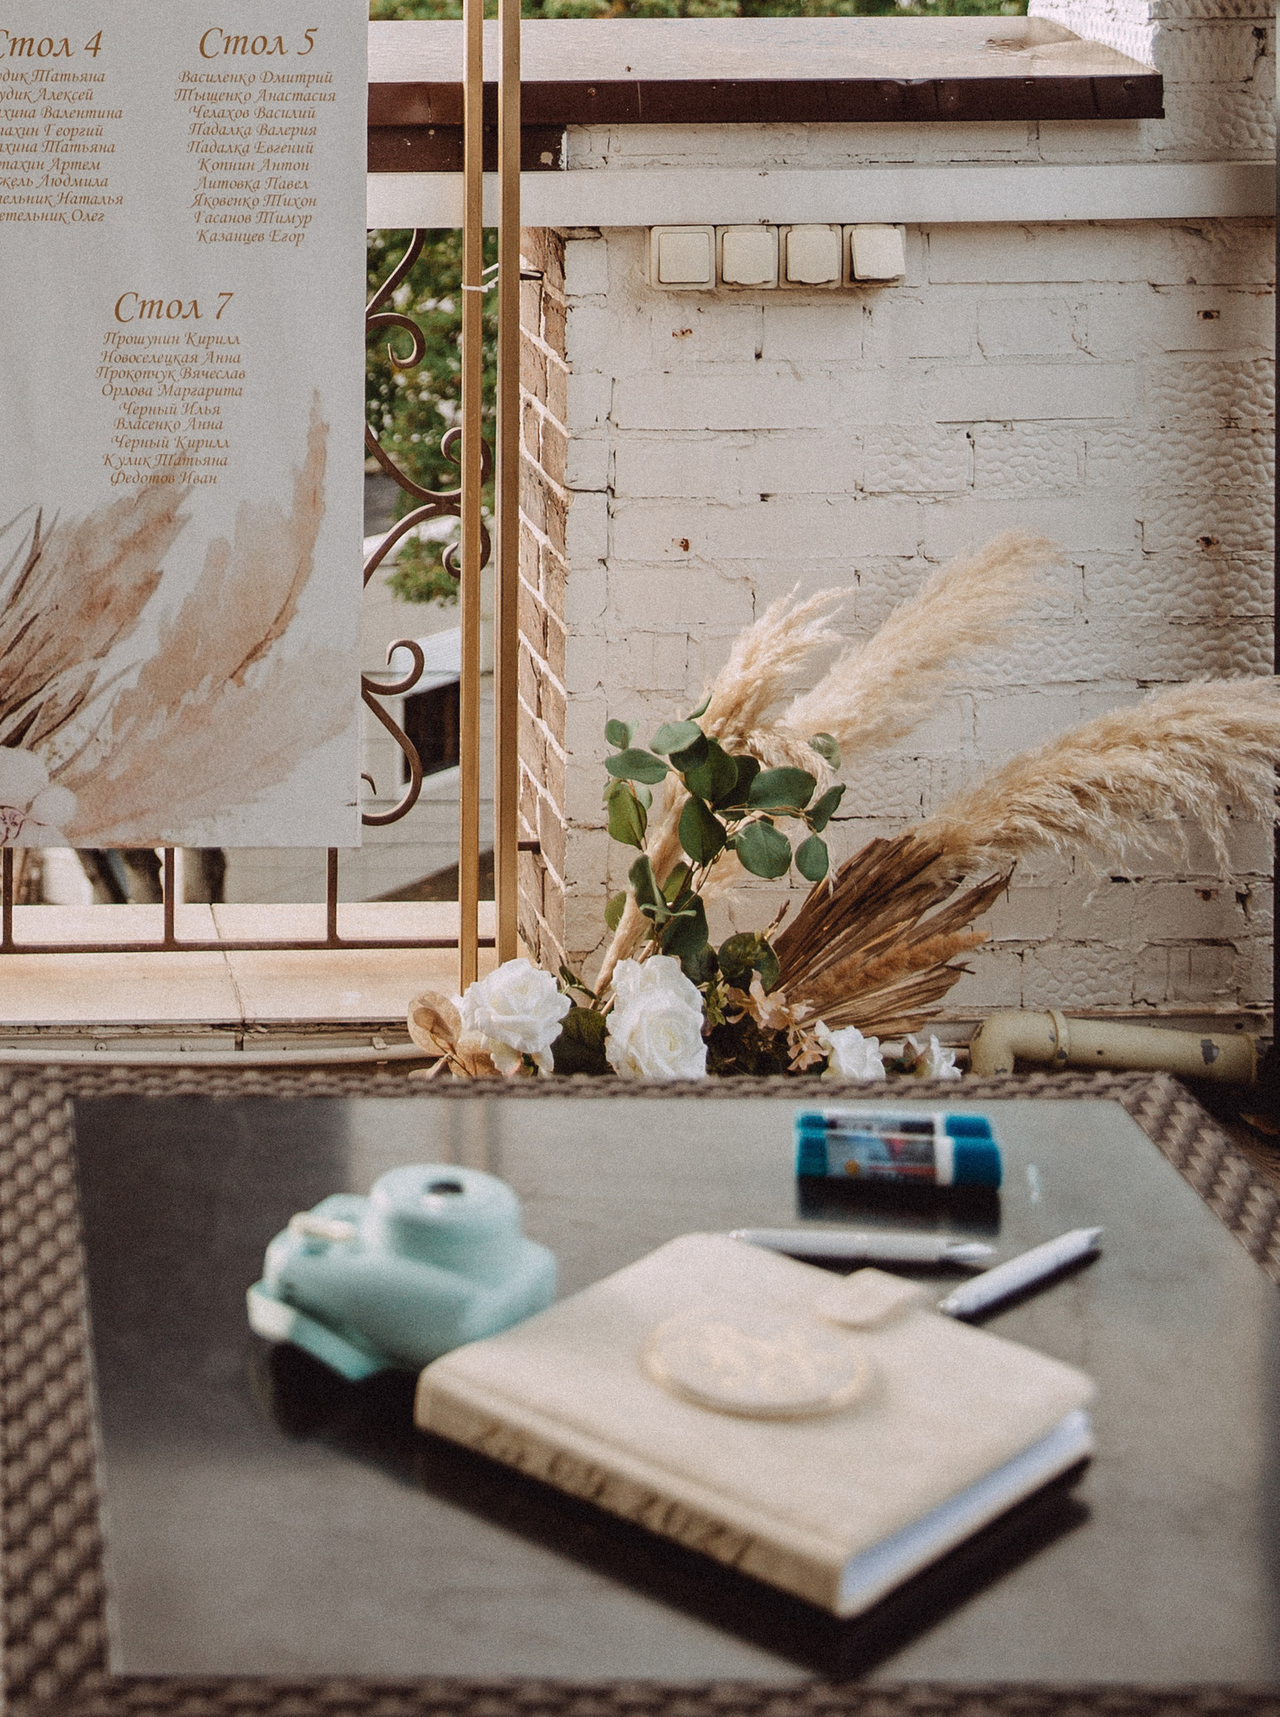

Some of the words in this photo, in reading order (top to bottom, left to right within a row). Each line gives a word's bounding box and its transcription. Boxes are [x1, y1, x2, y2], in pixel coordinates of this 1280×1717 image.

[84, 30, 102, 58] 4
[199, 27, 288, 59] Стол
[297, 28, 318, 56] 5
[32, 69, 105, 82] Татьяна
[179, 71, 256, 85] Василенко
[259, 71, 332, 87] Дмитрий
[34, 88, 93, 102] Алексей
[174, 89, 251, 103] Тыщенко
[254, 89, 336, 101] Анастасия
[41, 107, 122, 119] Валентина
[189, 106, 249, 118] Челахов
[254, 107, 315, 118] Василий
[44, 124, 103, 141] Георгий
[188, 123, 251, 138] Падалка
[256, 124, 317, 140] Валерия
[42, 140, 115, 153] Татьяна
[186, 141, 249, 155] Падалка
[254, 142, 313, 153] Евгений
[47, 158, 100, 175] Артем
[198, 158, 254, 172] Копнин
[258, 159, 309, 171] Антон
[36, 174, 108, 187] Людмила
[194, 177, 260, 192] Литовка
[264, 177, 308, 189] Павел
[55, 193, 123, 205] Наталья
[187, 193, 259, 208] Яковенко
[264, 195, 316, 209] Тихон
[71, 210, 104, 222] Олег
[194, 211, 251, 224] Гасанов
[256, 211, 312, 228] Тимур
[196, 230, 264, 244] Казанцев
[269, 230, 305, 247] Егор
[114, 292, 203, 323] Стол
[216, 292, 234, 320] 7
[102, 332, 179, 349] Прошунин
[185, 332, 240, 349] Кирилл
[100, 351, 197, 365] Новоселецкая
[201, 351, 240, 363] Анна
[96, 366, 179, 383] Прокопчук
[181, 368, 245, 379] Вячеслав
[102, 383, 152, 400] Орлова
[158, 385, 242, 401] Маргарита
[119, 402, 176, 419] Черный
[182, 403, 220, 415] Илья
[113, 418, 180, 431] Власенко
[183, 418, 223, 430] Анна
[111, 436, 168, 452] Черный
[174, 437, 229, 452] Кирилл
[102, 454, 155, 470] Кулик
[155, 454, 227, 466] Татьяна
[110, 471, 175, 485] Федотов
[179, 473, 216, 484] Иван
